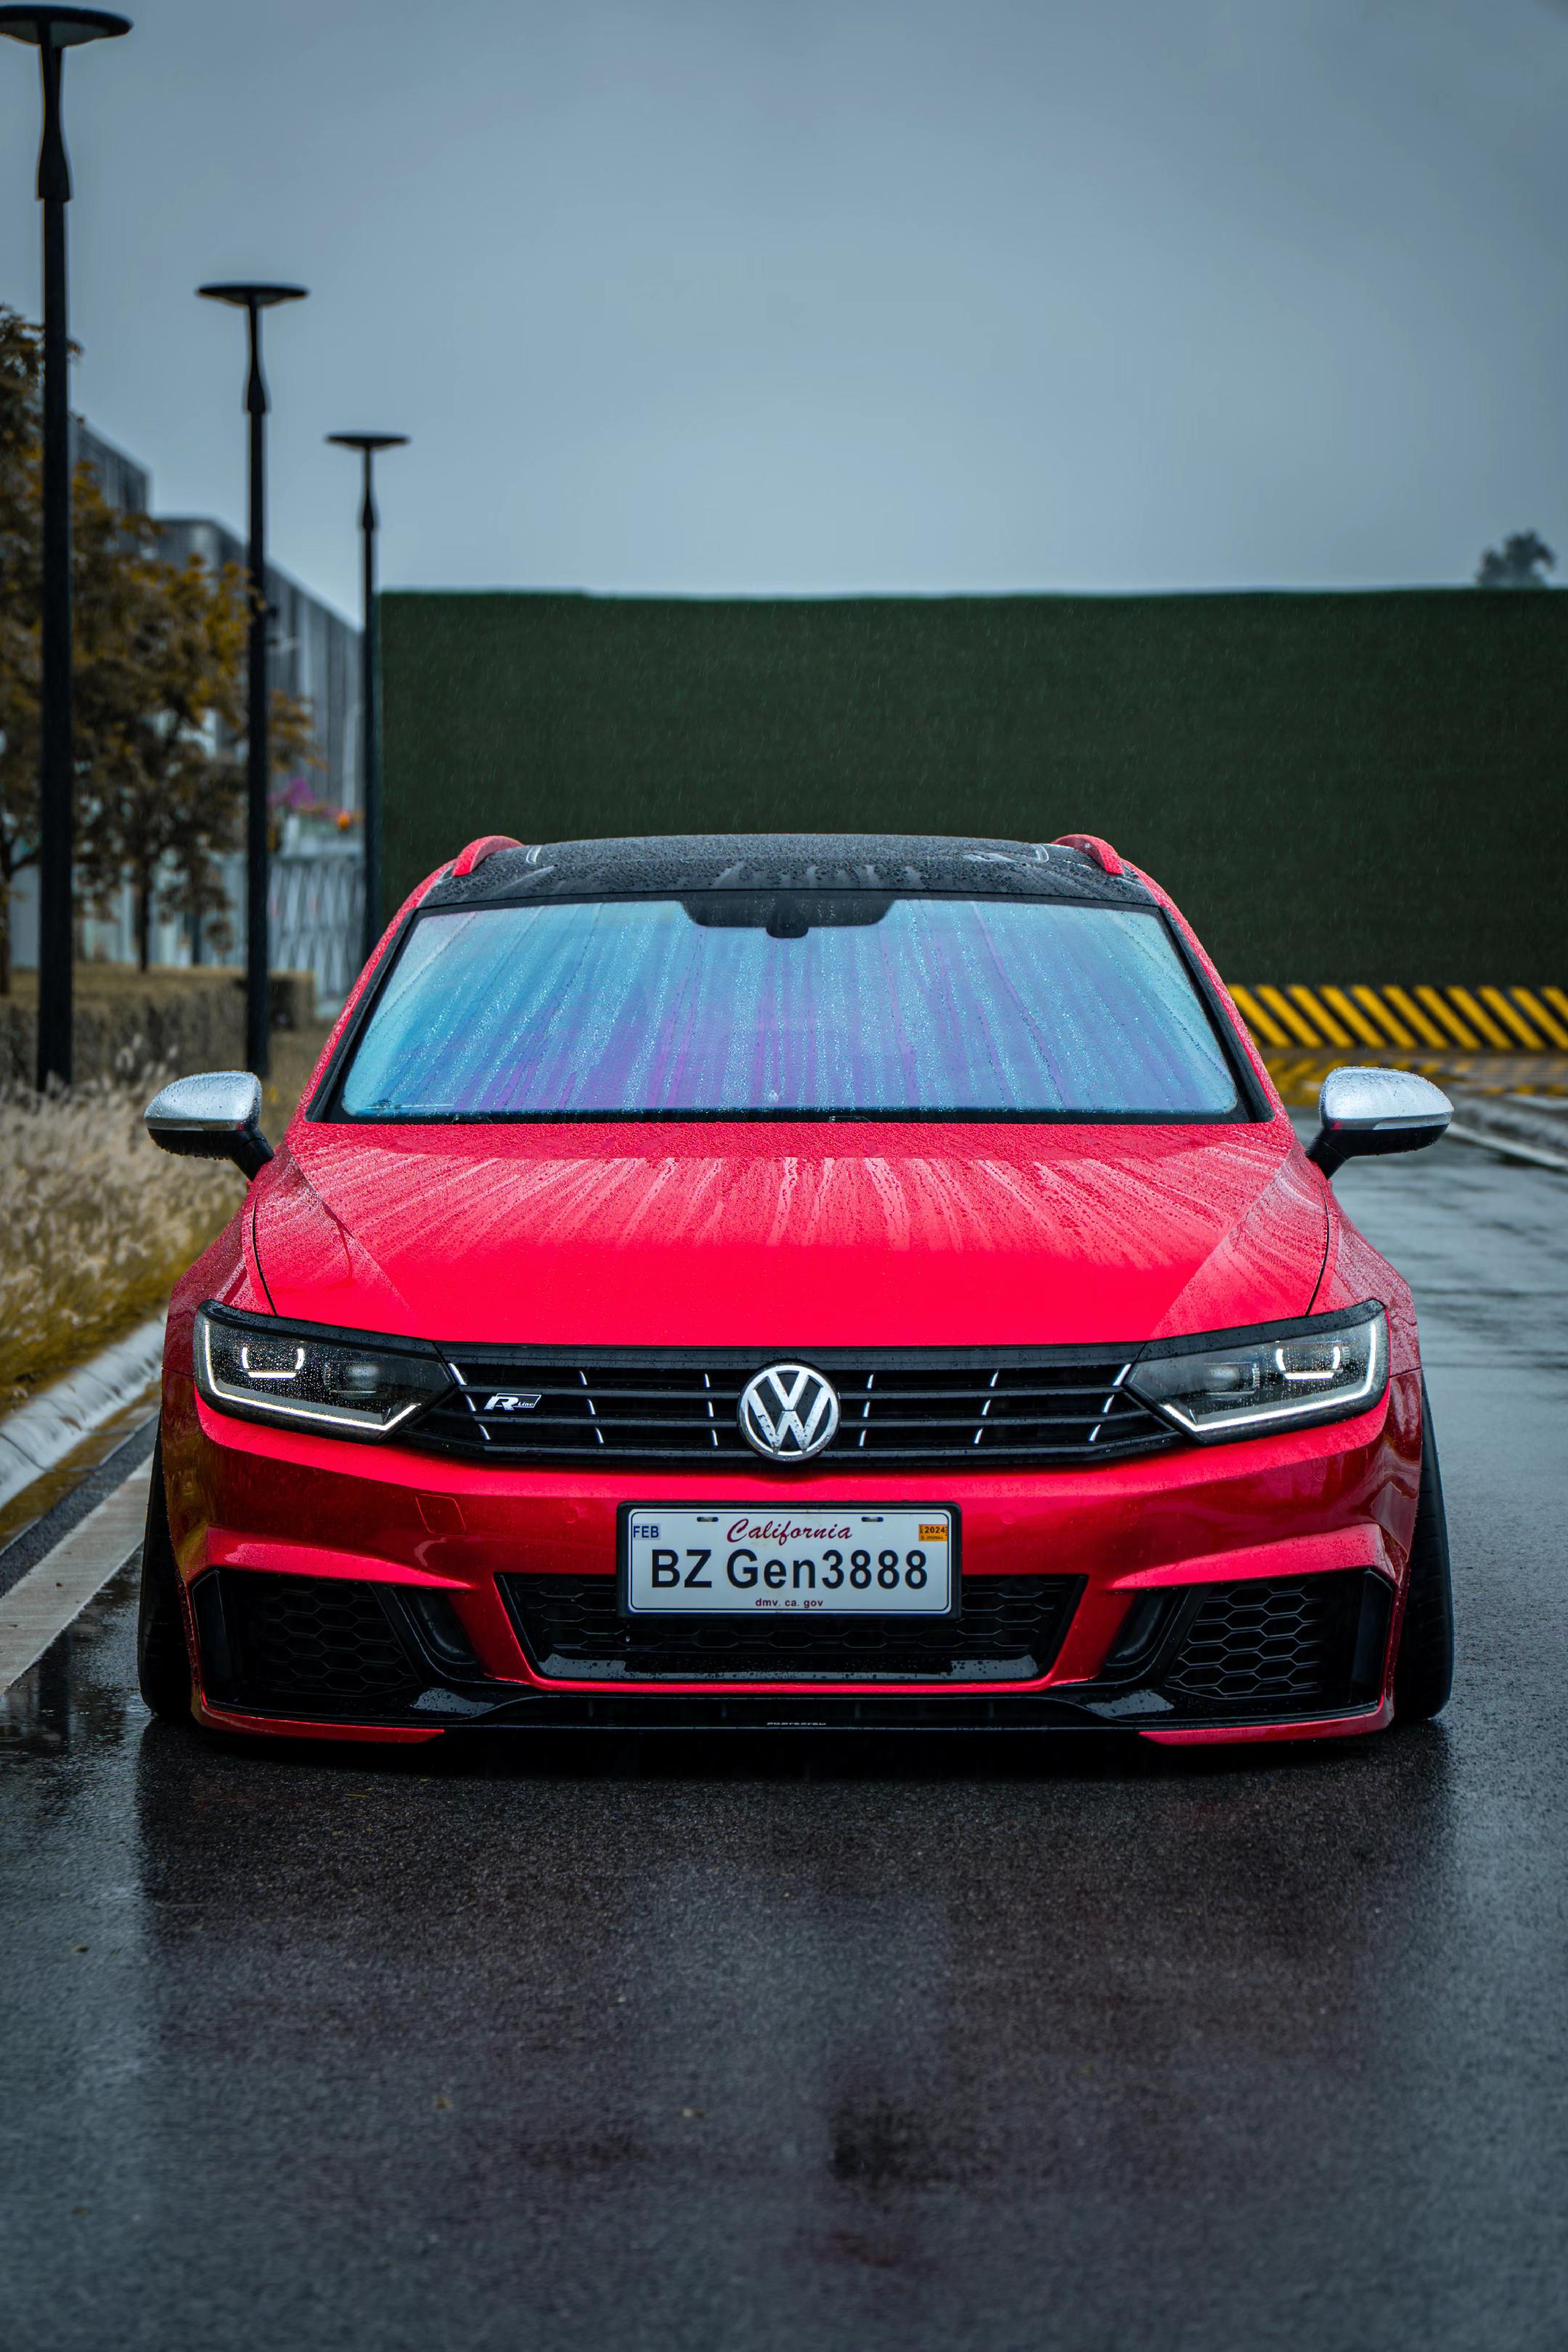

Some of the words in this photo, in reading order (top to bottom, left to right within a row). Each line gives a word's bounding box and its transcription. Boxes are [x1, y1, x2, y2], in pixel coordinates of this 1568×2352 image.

[633, 1526, 659, 1538] FEB
[727, 1519, 853, 1545] California
[652, 1549, 712, 1588] BZ
[727, 1548, 927, 1590] Gen3888
